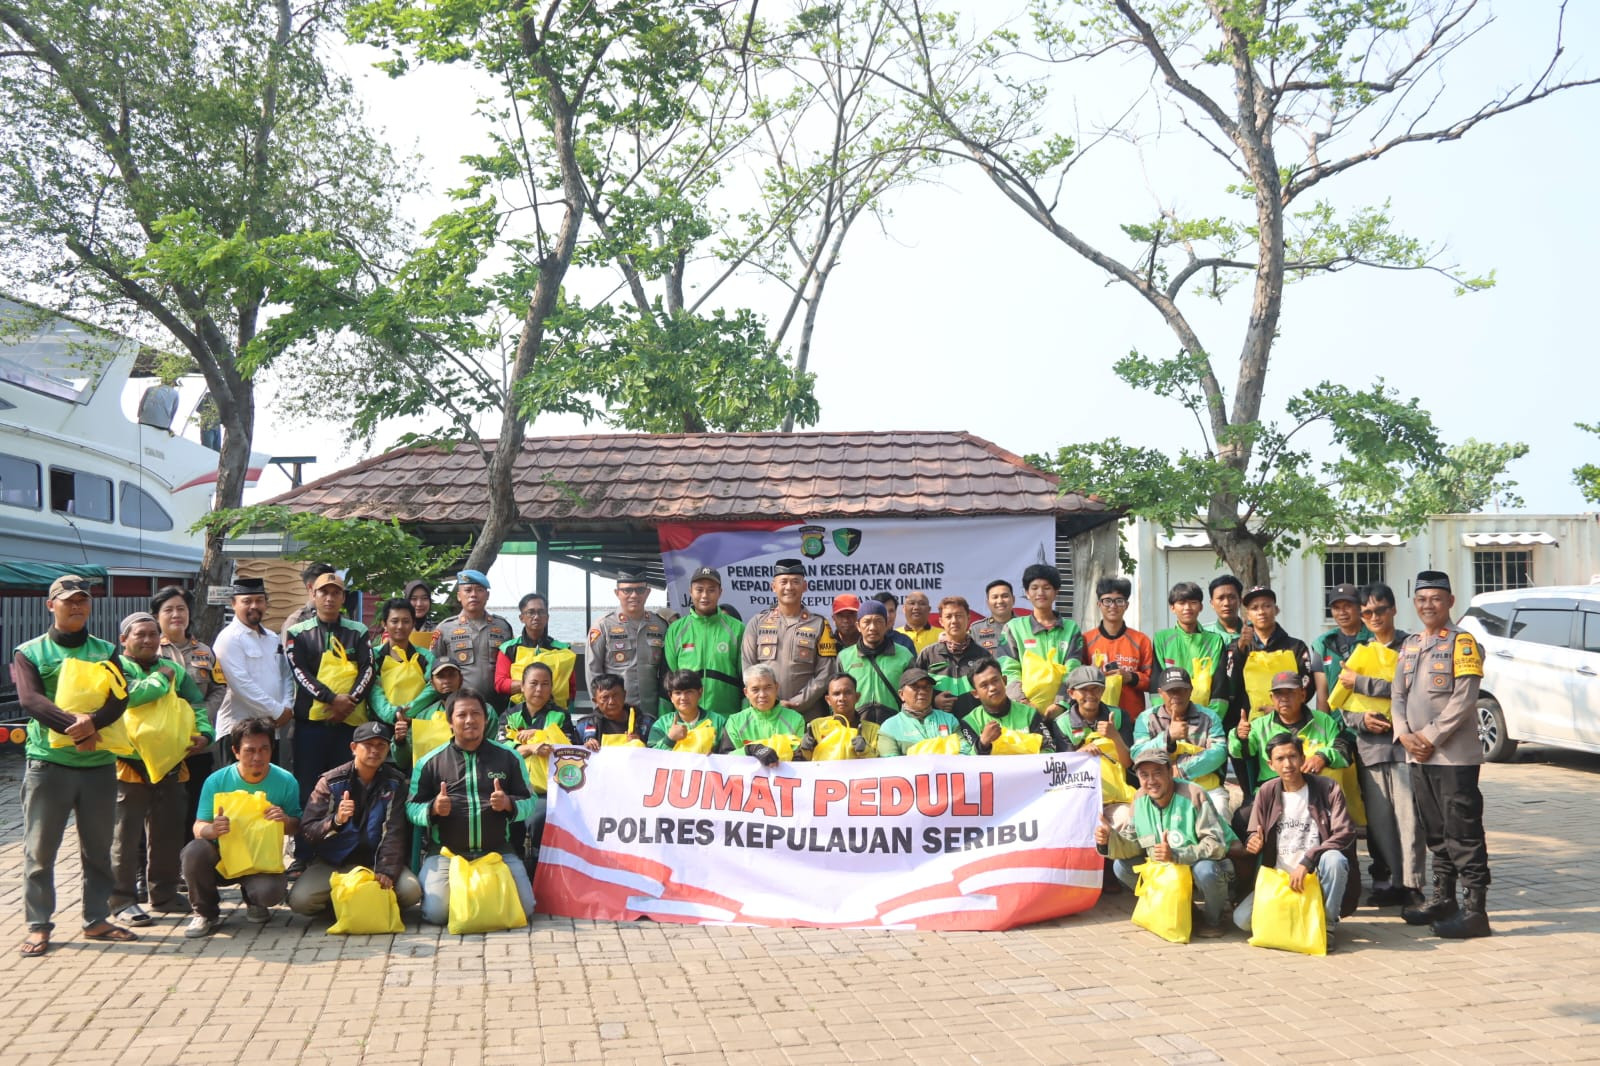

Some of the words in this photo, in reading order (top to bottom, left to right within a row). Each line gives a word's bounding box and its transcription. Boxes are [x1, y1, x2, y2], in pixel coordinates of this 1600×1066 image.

[727, 564, 817, 577] PEMERIAN
[821, 563, 895, 576] KESEHATAN
[898, 562, 944, 575] GRATIS
[731, 580, 773, 592] KEPAD
[807, 579, 856, 592] GEMUDI
[860, 579, 892, 591] OJEK
[895, 578, 942, 590] ONLINE
[1043, 758, 1068, 775] JAGA
[643, 768, 802, 818] JUMAT
[813, 772, 994, 817] PEDULI
[597, 817, 715, 846] POLRES
[724, 820, 913, 854] KEPULAUAN
[922, 820, 1039, 854] SERIBU
